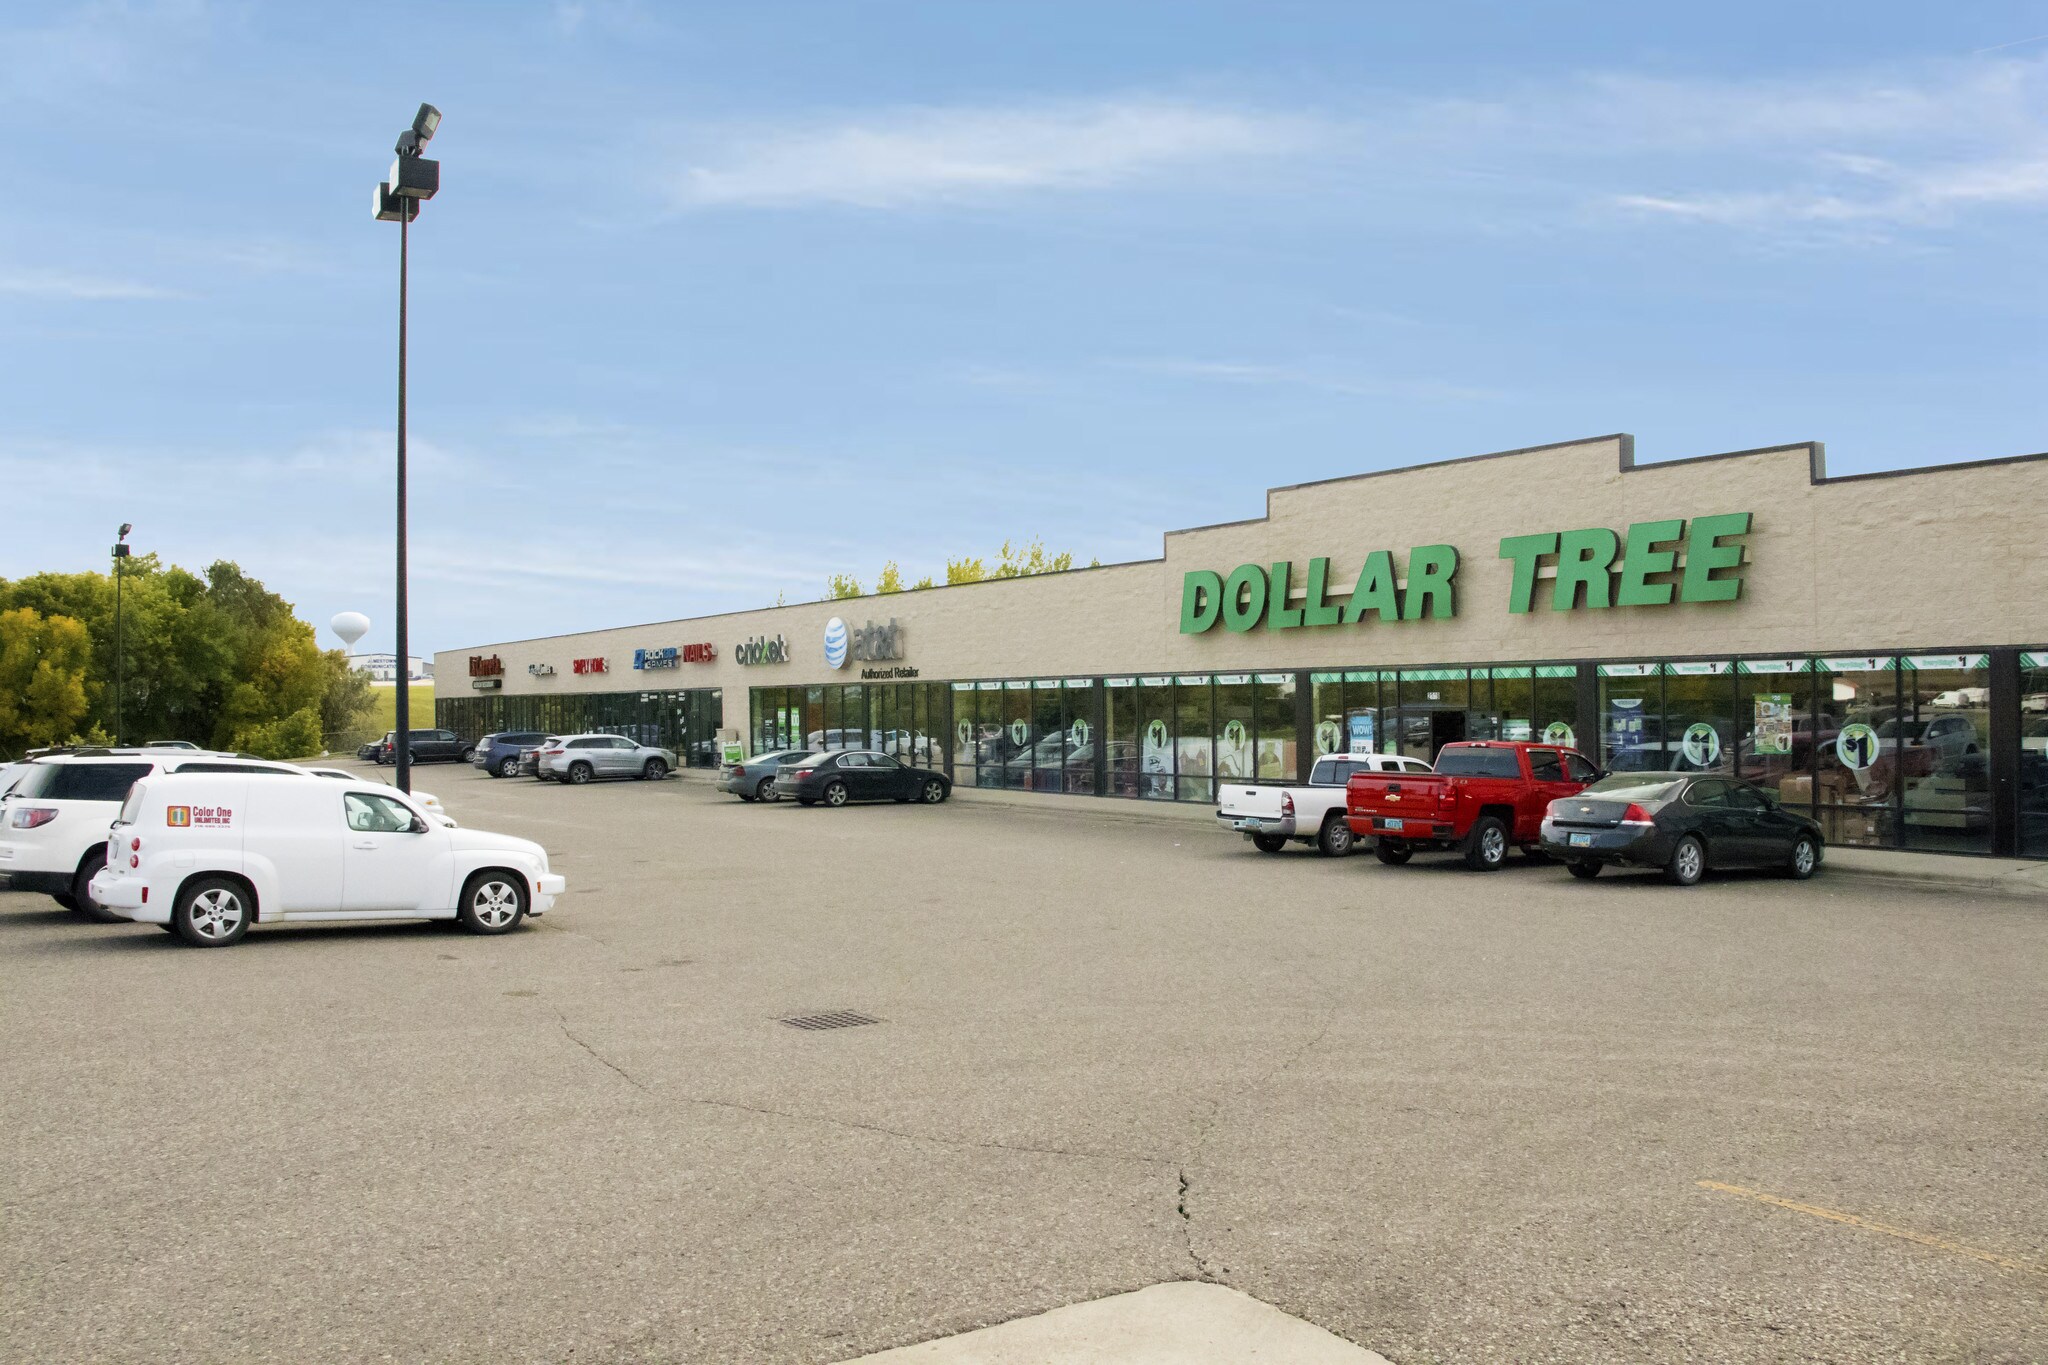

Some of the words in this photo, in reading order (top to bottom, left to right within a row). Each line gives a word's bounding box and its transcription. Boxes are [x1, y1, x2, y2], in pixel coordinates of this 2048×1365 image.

[1180, 544, 1459, 634] DOLLAR
[1500, 512, 1753, 614] TREE
[683, 643, 712, 662] NAILS
[735, 634, 788, 665] cricket
[861, 668, 893, 679] Authorized
[894, 666, 919, 678] Retailer
[1352, 725, 1372, 735] WOW!
[1846, 733, 1868, 768] $1
[193, 806, 214, 816] Color
[217, 806, 232, 817] One
